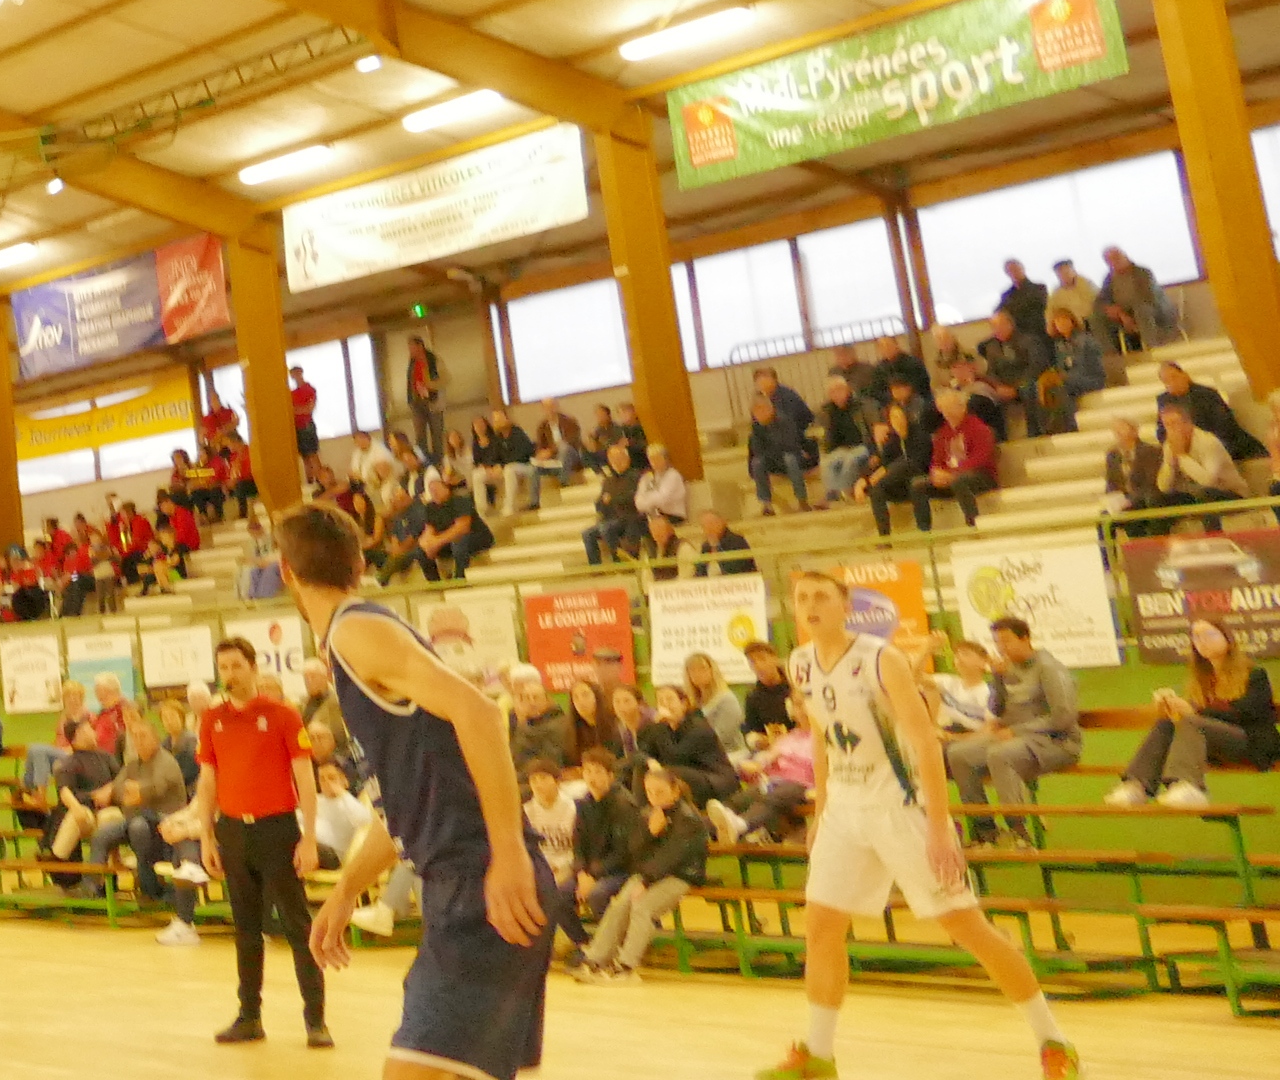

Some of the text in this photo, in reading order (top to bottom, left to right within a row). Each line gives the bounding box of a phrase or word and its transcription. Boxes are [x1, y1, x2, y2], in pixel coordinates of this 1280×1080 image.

[881, 35, 1025, 127] sport
[766, 105, 870, 150] une région
[538, 610, 554, 630] LE
[822, 685, 837, 712] 9
